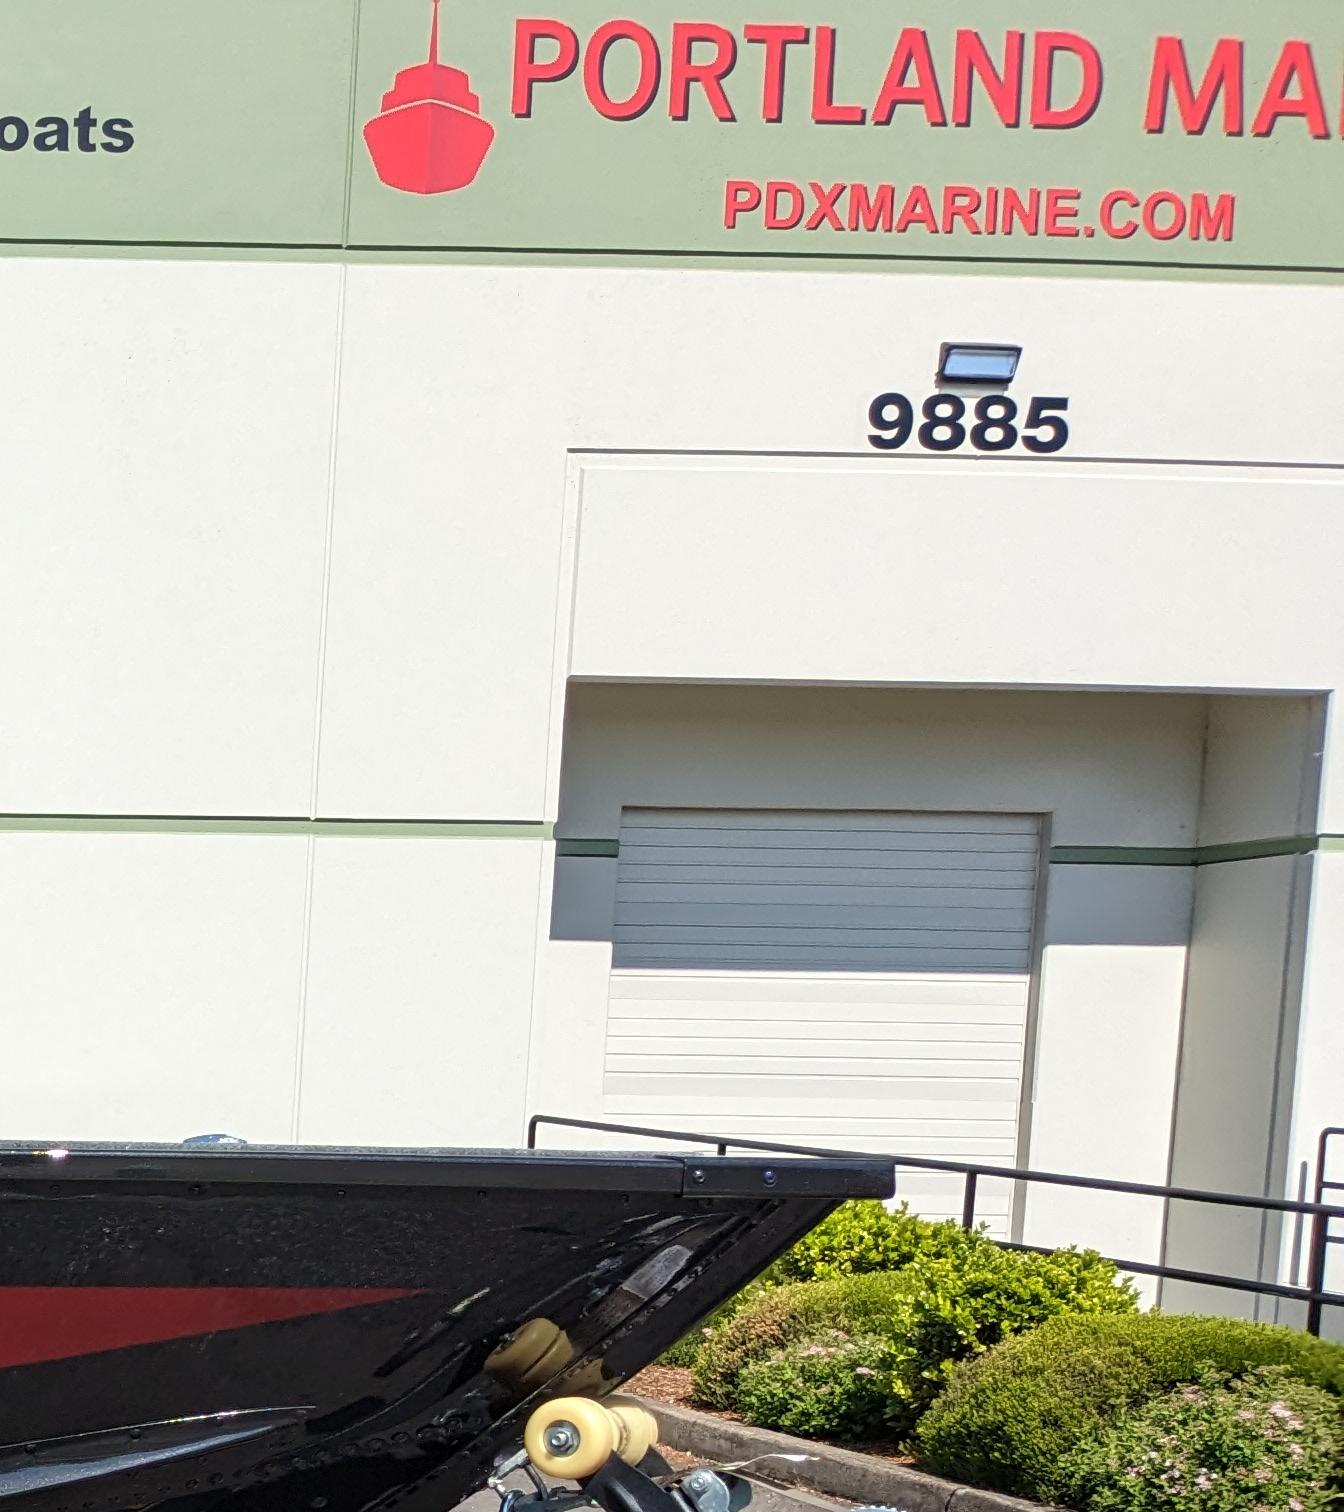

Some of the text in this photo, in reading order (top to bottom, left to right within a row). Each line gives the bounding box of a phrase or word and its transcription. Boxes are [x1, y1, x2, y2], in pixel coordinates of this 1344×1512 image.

[511, 18, 1344, 140] PORTLAND MA
[723, 179, 1236, 242] PDXMARINE.COM
[867, 393, 1070, 455] 9885
